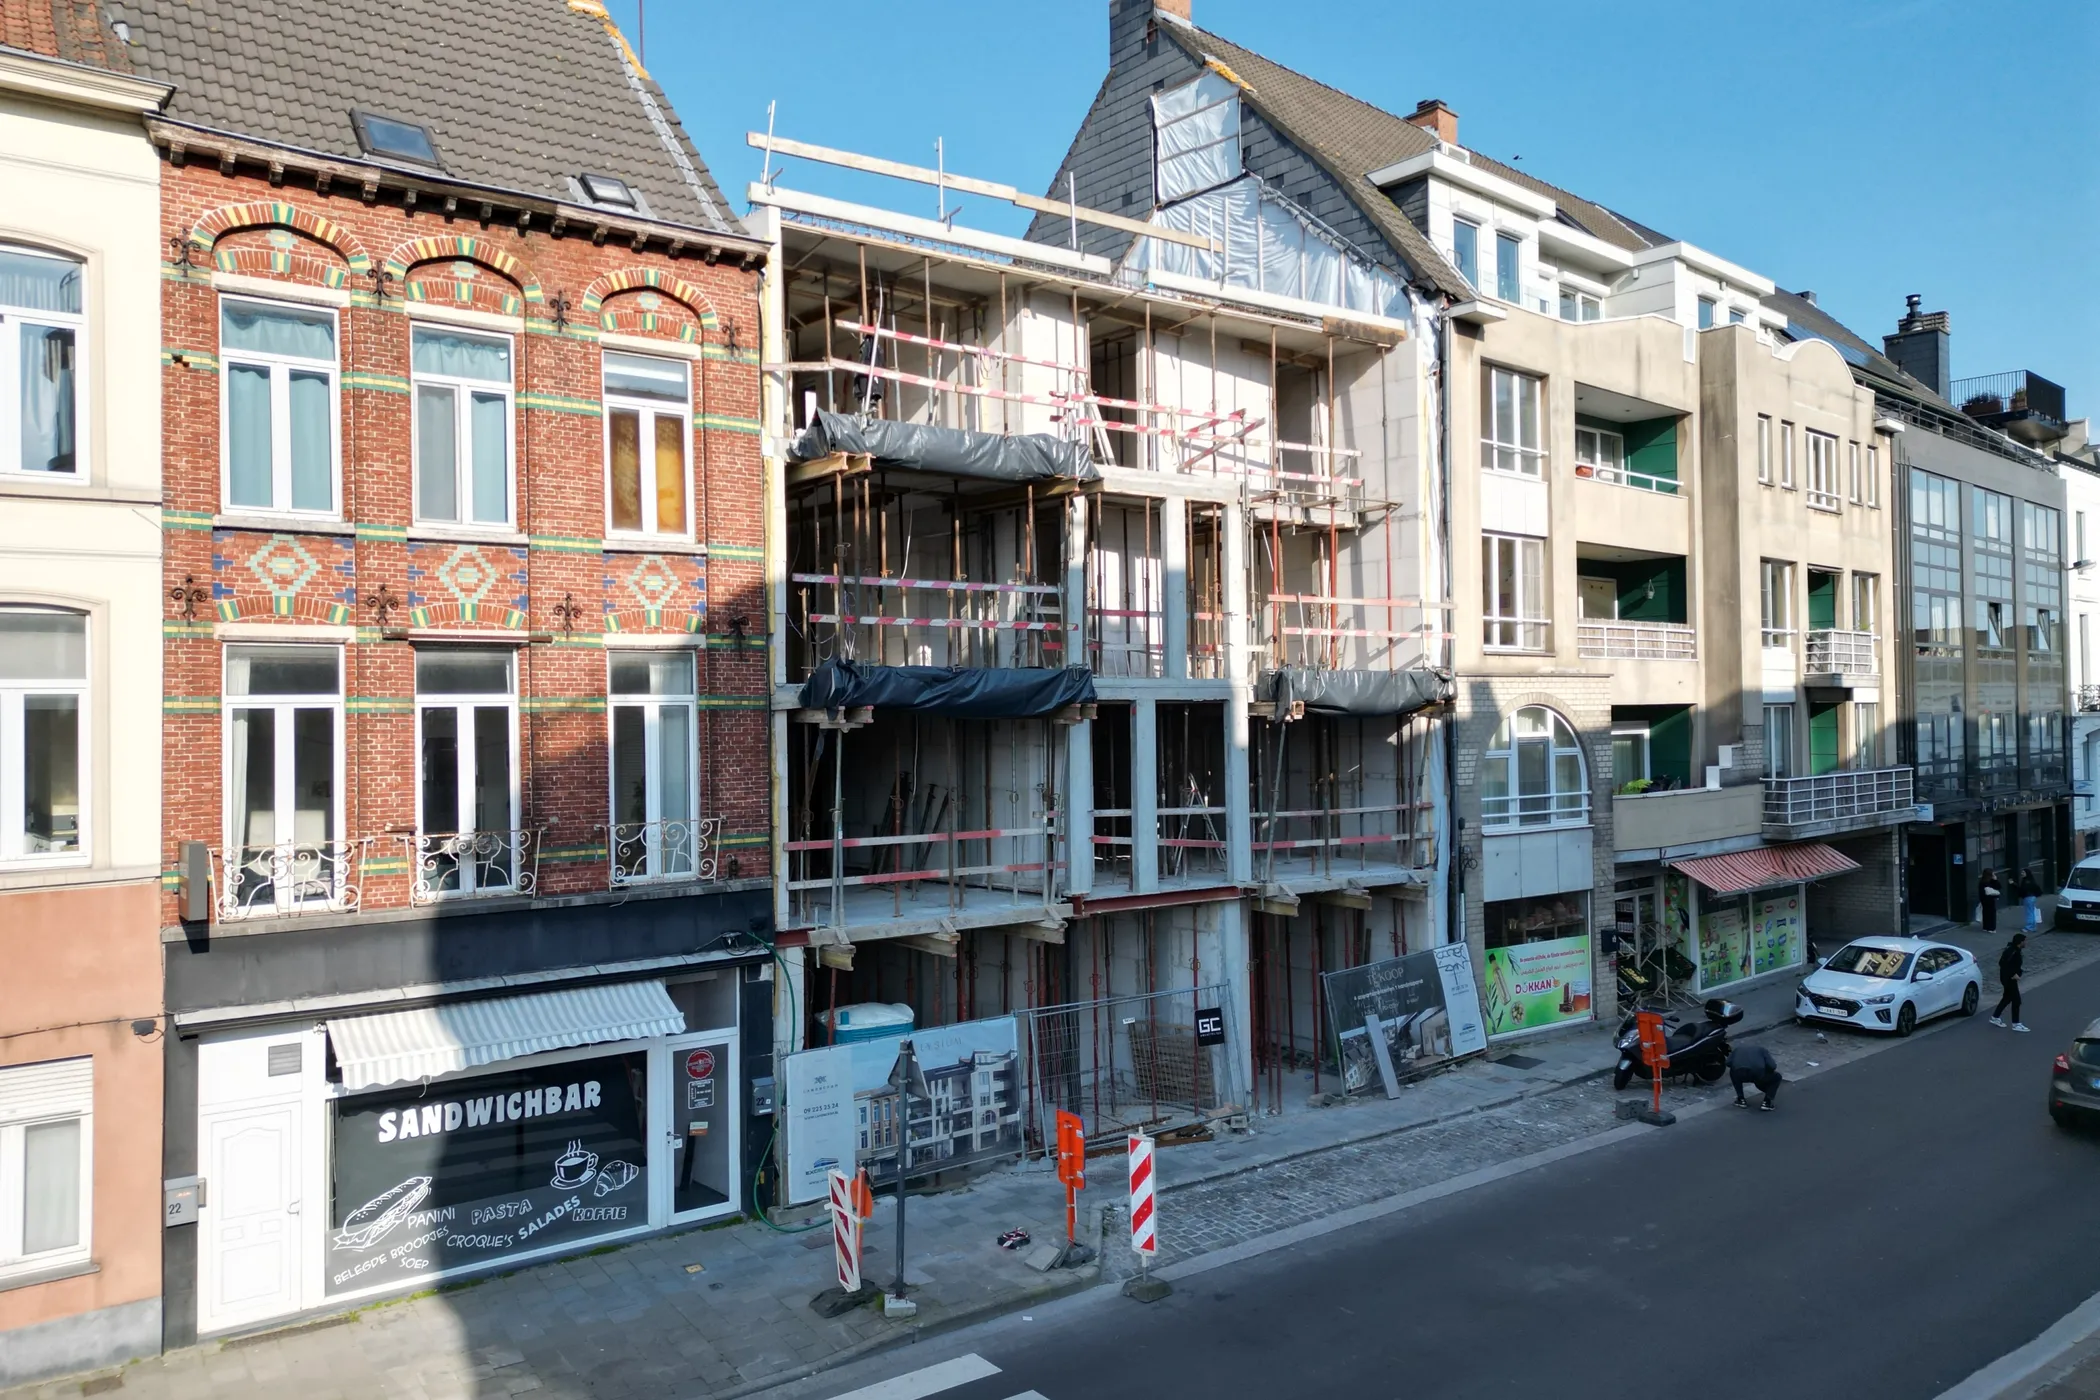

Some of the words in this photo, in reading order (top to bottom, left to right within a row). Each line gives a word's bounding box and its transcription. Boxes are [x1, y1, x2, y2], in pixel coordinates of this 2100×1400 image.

[1199, 1017, 1221, 1033] GC
[920, 1036, 962, 1053] LYSIUM
[755, 1096, 765, 1106] 22
[378, 1080, 602, 1143] SANDWICHBAR
[168, 1203, 181, 1215] 22
[471, 1198, 534, 1226] PASTA
[572, 1206, 628, 1222] KOFFIE
[407, 1207, 456, 1230] PANINI
[517, 1195, 582, 1241] SALADES
[446, 1234, 514, 1249] CROQUE'S
[333, 1253, 388, 1286] BELEGDE
[390, 1225, 450, 1260] BROODJES
[399, 1256, 429, 1270] SOEP
